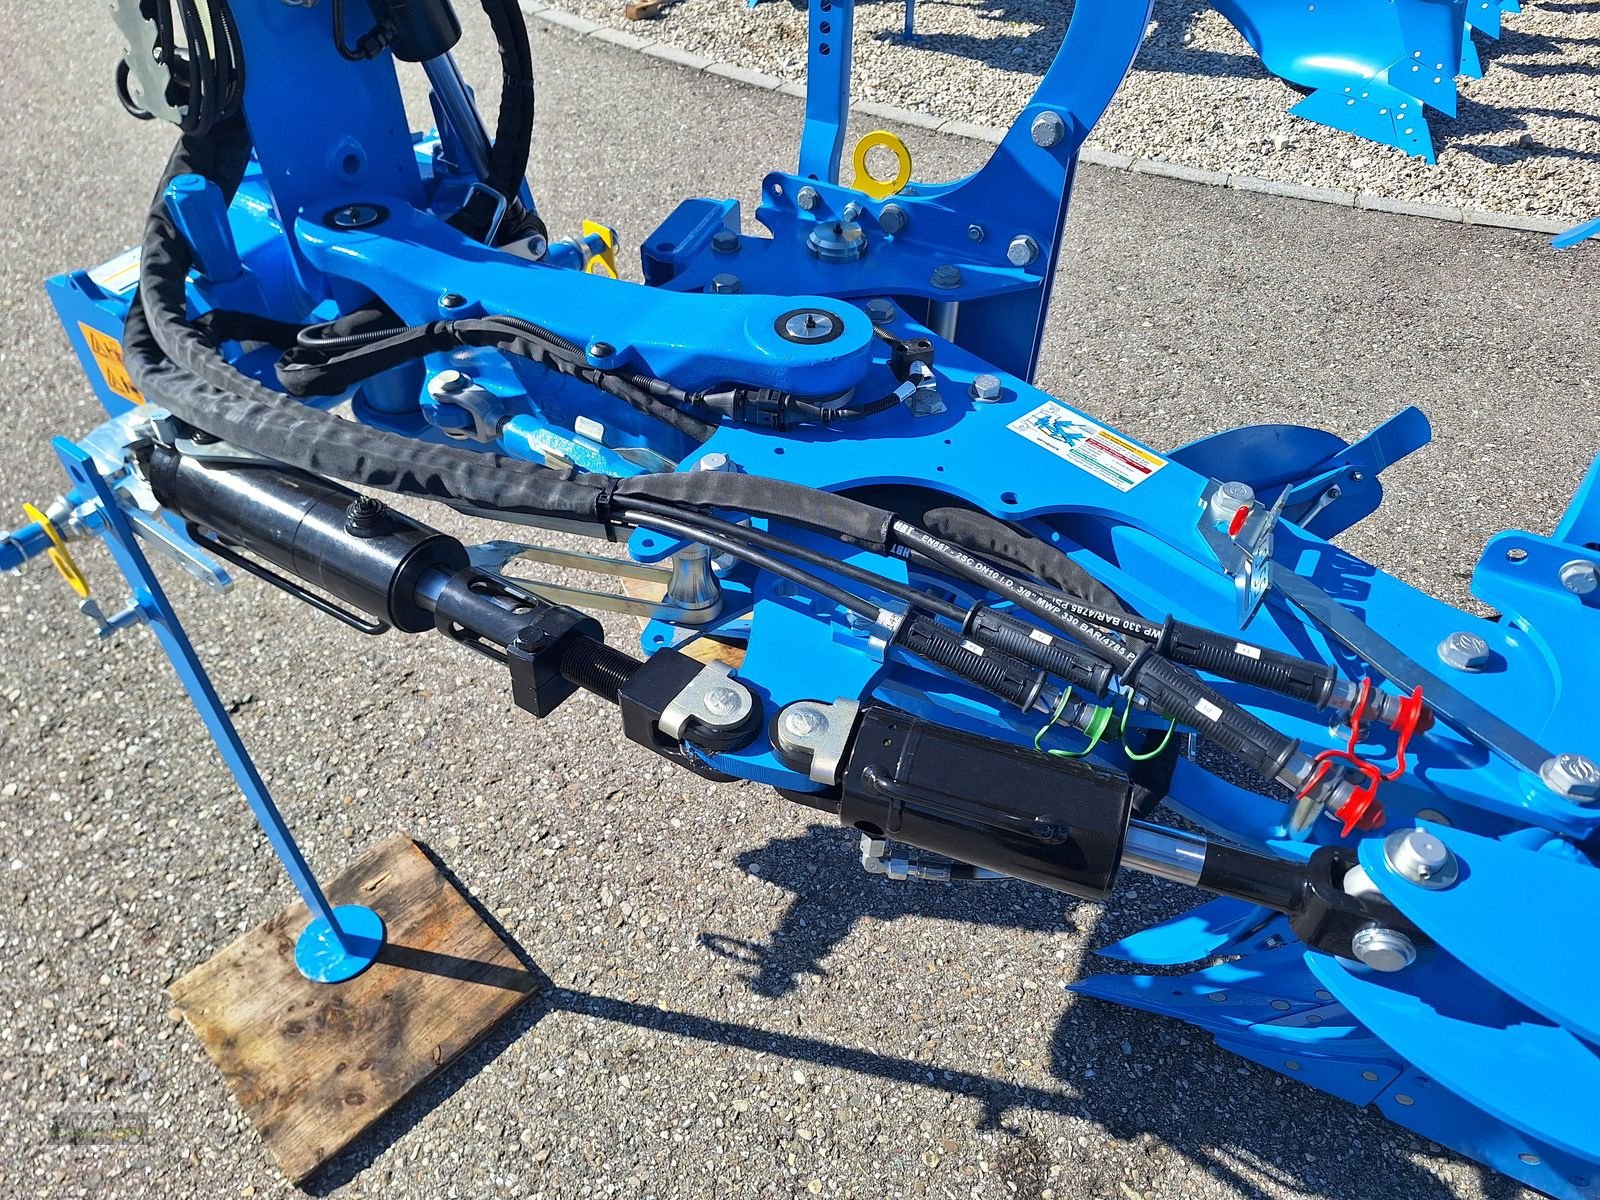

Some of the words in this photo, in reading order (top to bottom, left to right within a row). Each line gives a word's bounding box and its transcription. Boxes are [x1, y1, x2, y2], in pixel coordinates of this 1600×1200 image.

[955, 552, 975, 566] 2SC
[975, 563, 999, 579] DN10
[1037, 597, 1060, 614] MWP
[1061, 612, 1079, 626] 330
[1079, 622, 1127, 654] BAR/4785
[1071, 605, 1121, 625] BAR/4785
[1123, 622, 1142, 633] 330
